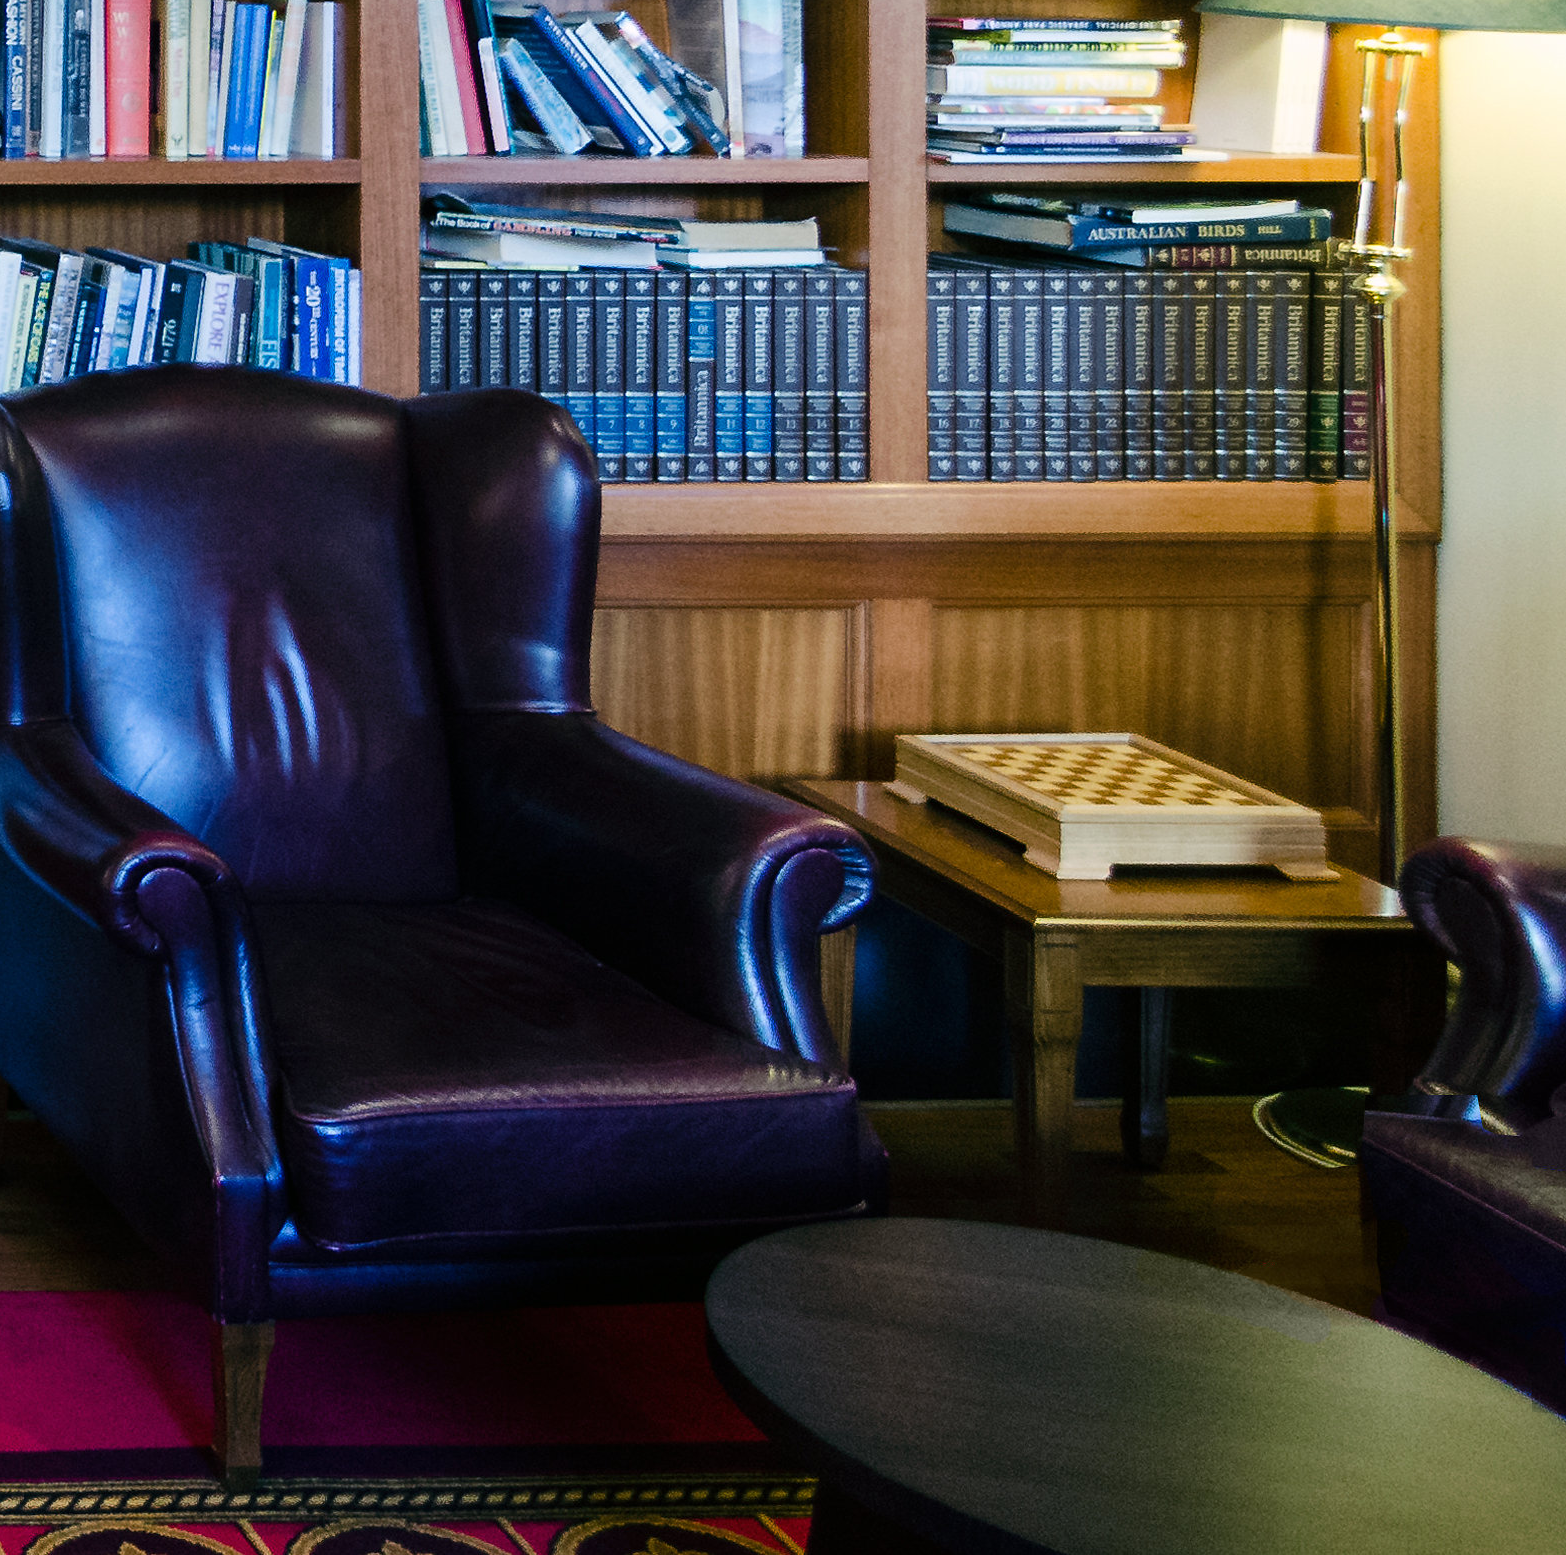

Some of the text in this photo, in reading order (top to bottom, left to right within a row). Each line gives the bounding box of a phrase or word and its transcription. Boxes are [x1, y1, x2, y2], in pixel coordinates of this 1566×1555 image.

[11, 55, 23, 111] CASSINI
[439, 217, 456, 227] The
[457, 218, 481, 229] Book
[1088, 224, 1283, 240] AUSTRALIAN BIRDS HILL
[1242, 248, 1321, 264] Britannica
[27, 282, 50, 362] THE AGE OF CARS
[208, 282, 230, 350] EXPLORE
[333, 268, 346, 355] ENCYCLOPEDIA OF
[458, 306, 475, 383] Britannica
[489, 306, 506, 383] Britannica
[518, 306, 535, 383] Britannica
[575, 306, 592, 383] Britannica
[605, 306, 622, 383] Britannica
[635, 306, 652, 383] Britannica
[724, 306, 741, 383] Britannica
[753, 306, 770, 383] Britannica
[784, 306, 801, 383] Britannica
[846, 306, 863, 383] Britannica
[936, 305, 953, 383] Britannica
[996, 305, 1013, 383] Britannica
[1024, 305, 1041, 383] Britannica
[1050, 305, 1067, 383] Britannica
[1105, 305, 1122, 383] Britannica
[1134, 305, 1151, 383] Britannica
[1164, 305, 1181, 383] Britannica
[1227, 305, 1244, 383] Britannica
[1257, 305, 1274, 383] Britannica
[1287, 305, 1304, 383] Britannica
[261, 339, 278, 369] FIS
[692, 369, 710, 447] Britannica
